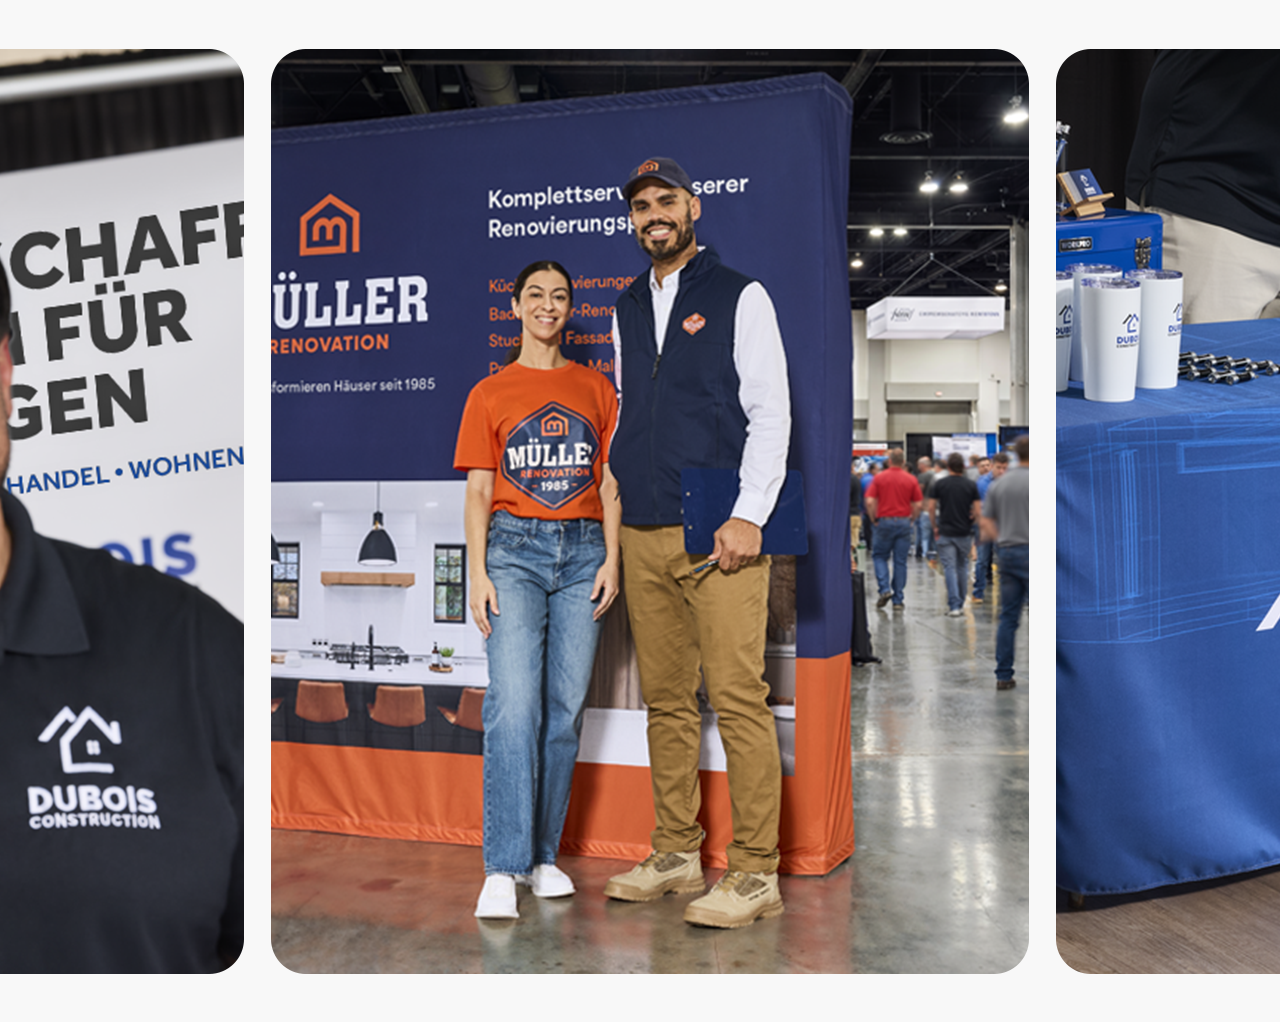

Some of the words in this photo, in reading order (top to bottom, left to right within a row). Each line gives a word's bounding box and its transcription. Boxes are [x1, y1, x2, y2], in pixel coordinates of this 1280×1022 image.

[272, 270, 429, 330] ÜLLER
[44, 280, 192, 361] FÜR
[271, 334, 389, 354] RENOVATION
[271, 379, 331, 394] formieren
[333, 379, 377, 392] Häuser
[379, 378, 403, 391] seit
[404, 376, 436, 390] 1985
[9, 368, 148, 441] GEN
[6, 466, 110, 494] HANDEL
[128, 446, 244, 479] WOHNEN
[520, 468, 591, 479] RENOVATION
[541, 480, 569, 491] 1985
[27, 784, 158, 815] DUBOIS
[28, 812, 162, 830] CONSTRUCTION
